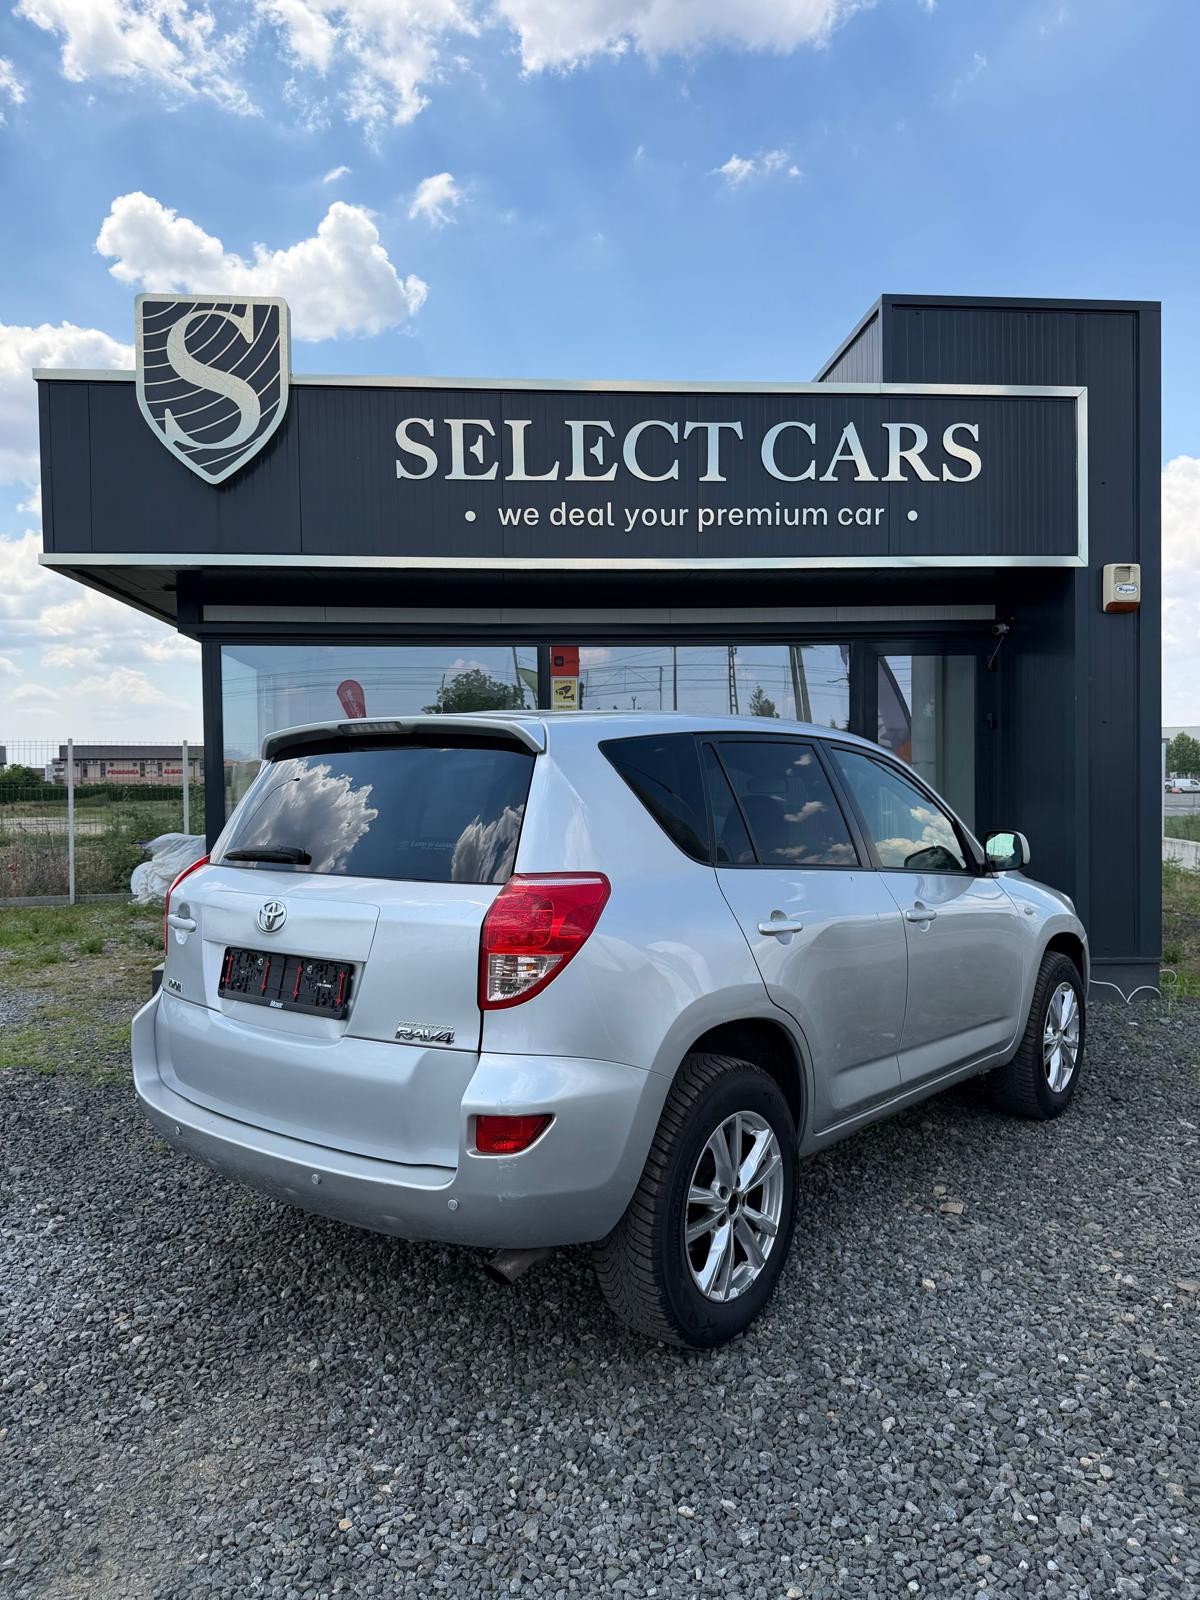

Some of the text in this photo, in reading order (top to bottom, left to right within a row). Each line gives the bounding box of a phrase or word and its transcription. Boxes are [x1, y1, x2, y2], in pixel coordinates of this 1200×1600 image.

[166, 303, 261, 450] S
[394, 417, 983, 484] SELECT CARS
[497, 501, 885, 533] we deal your premium car
[395, 1026, 455, 1045] RAV4
